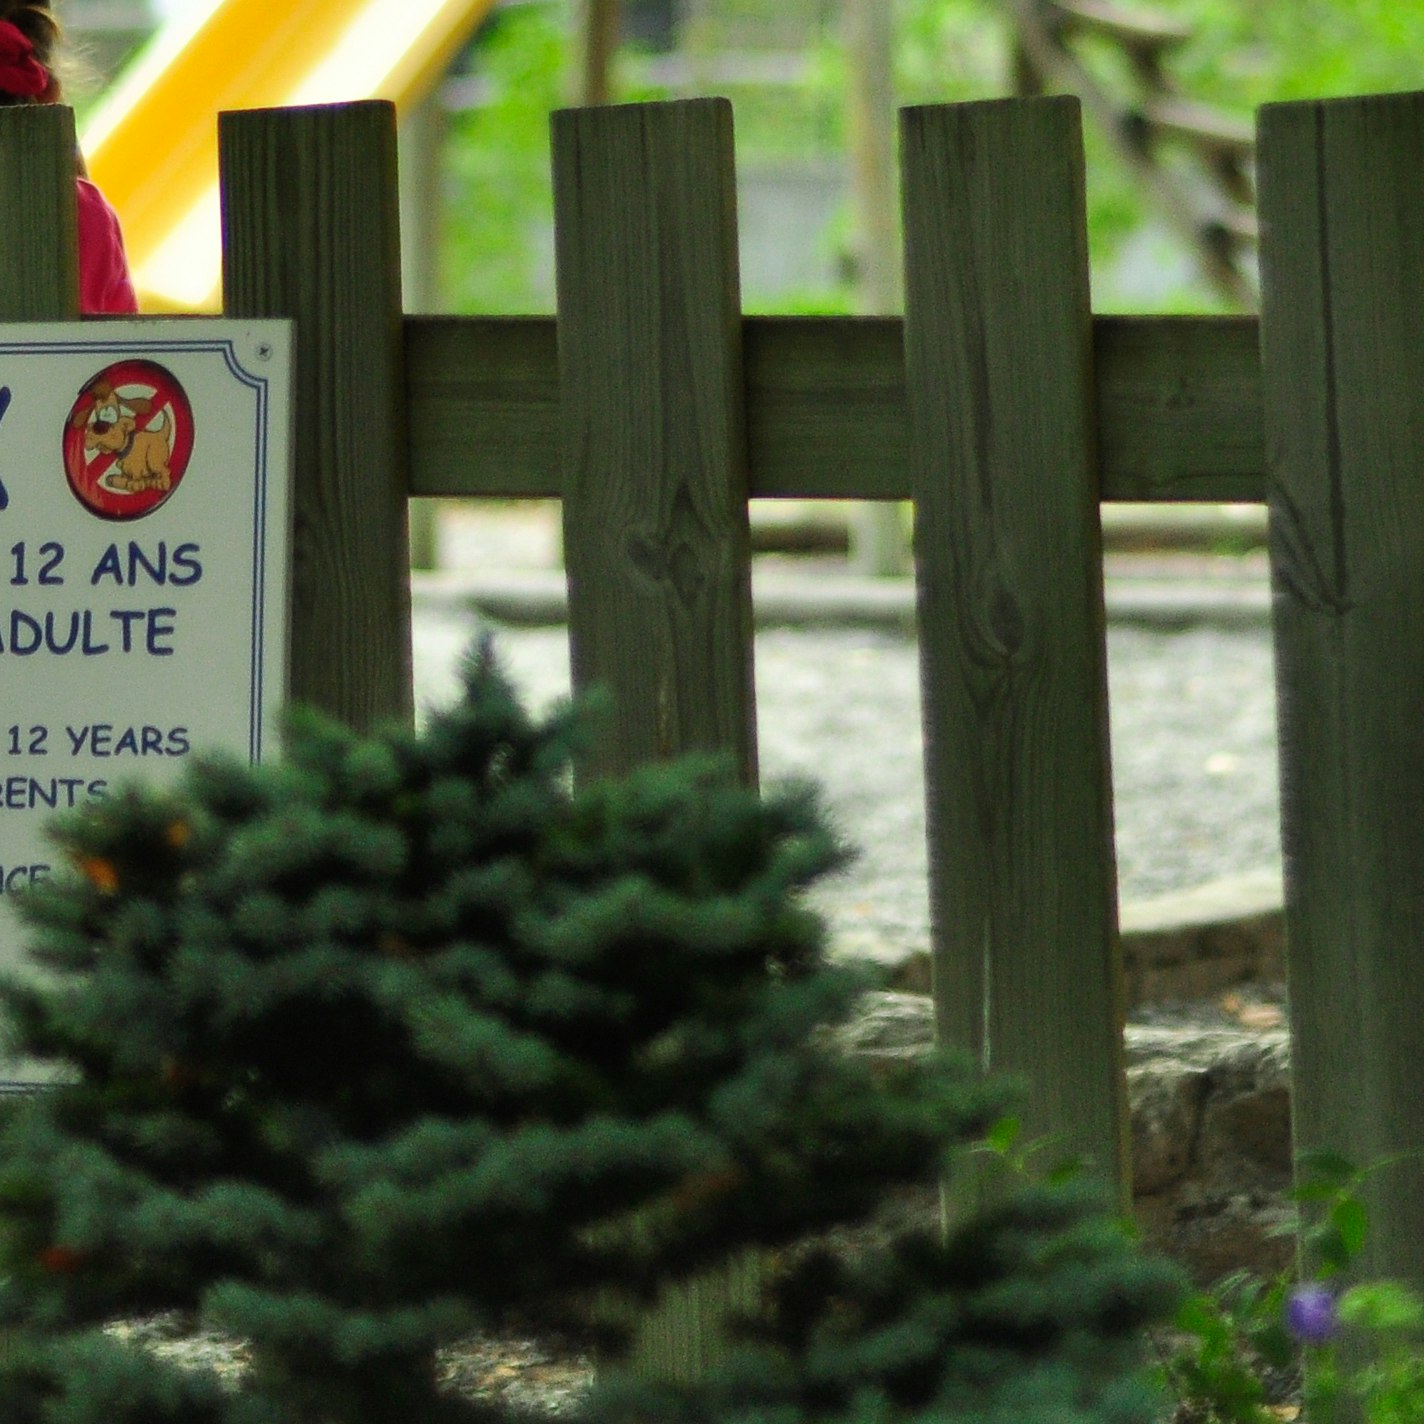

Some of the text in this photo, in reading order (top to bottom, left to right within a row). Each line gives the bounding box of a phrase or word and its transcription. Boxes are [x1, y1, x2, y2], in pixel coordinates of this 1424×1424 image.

[9, 541, 65, 586] 12
[90, 540, 203, 587] ANS
[8, 724, 48, 756] 12
[65, 724, 190, 758] YEARS
